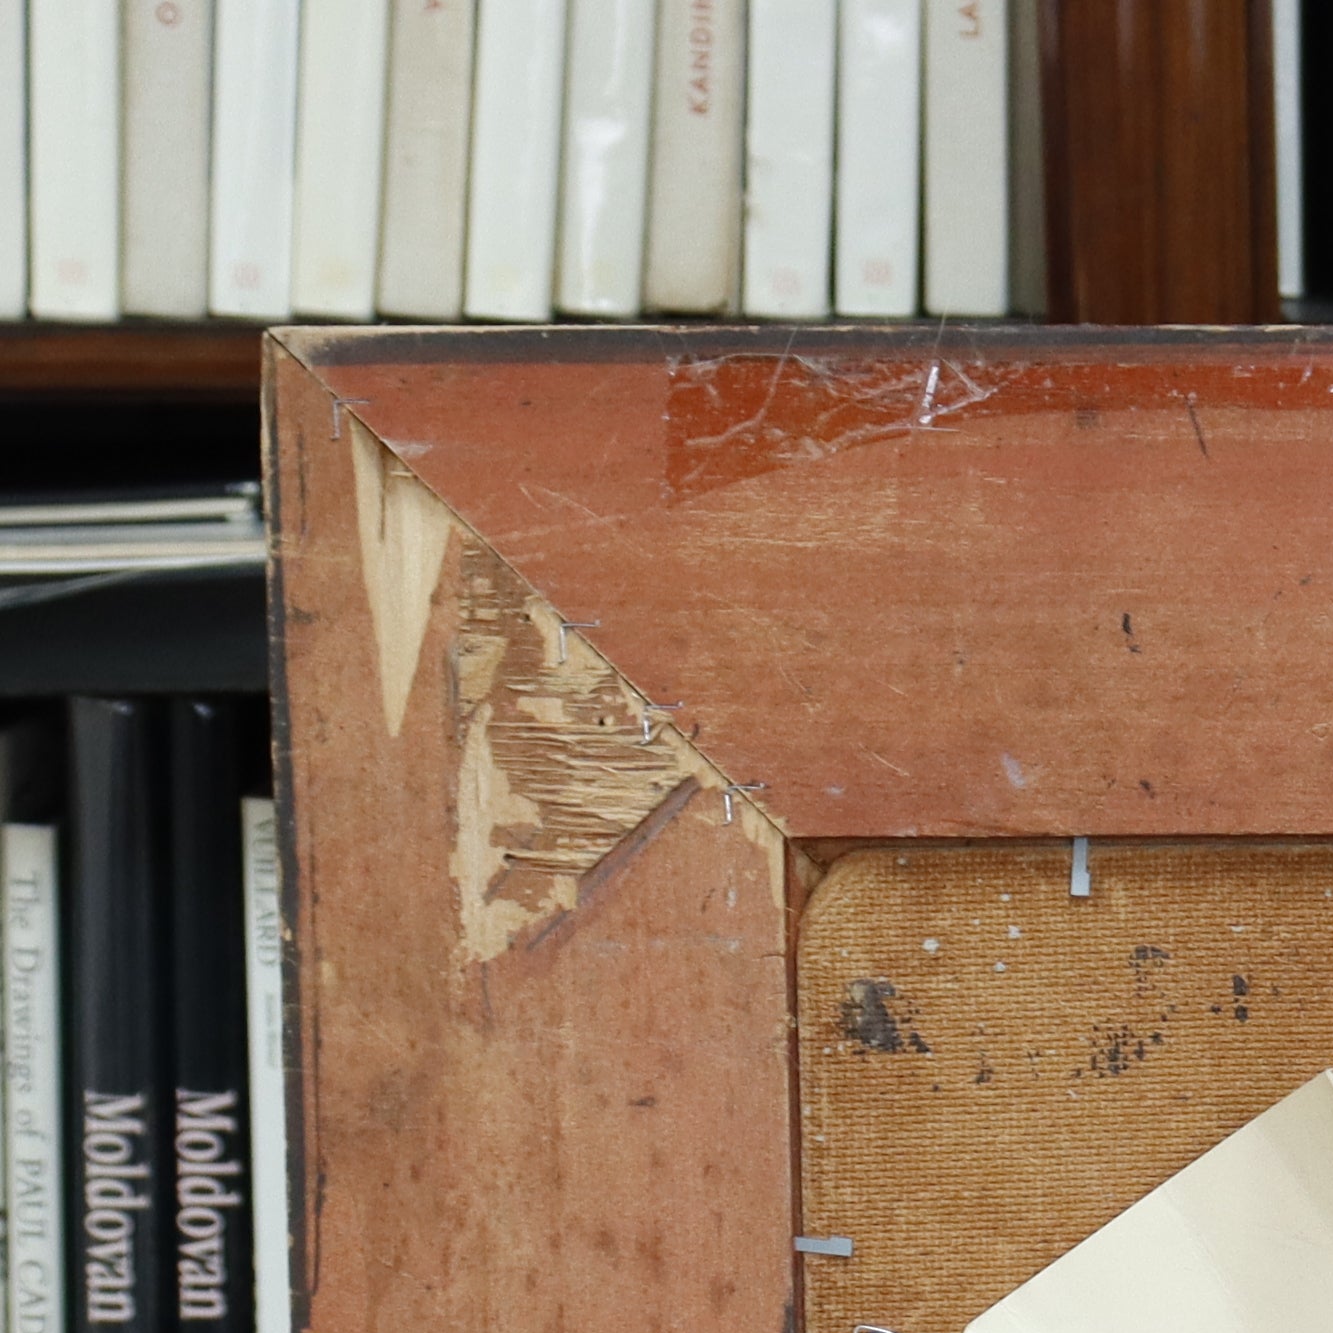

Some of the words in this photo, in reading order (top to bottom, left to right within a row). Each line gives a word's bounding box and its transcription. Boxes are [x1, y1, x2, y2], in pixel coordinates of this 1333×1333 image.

[11, 871, 40, 929] The
[8, 948, 40, 1094] Drawings
[16, 1108, 48, 1143] of
[15, 1156, 44, 1242] PAUL
[84, 1089, 152, 1323] Moldovan
[176, 1087, 244, 1320] Moldovan
